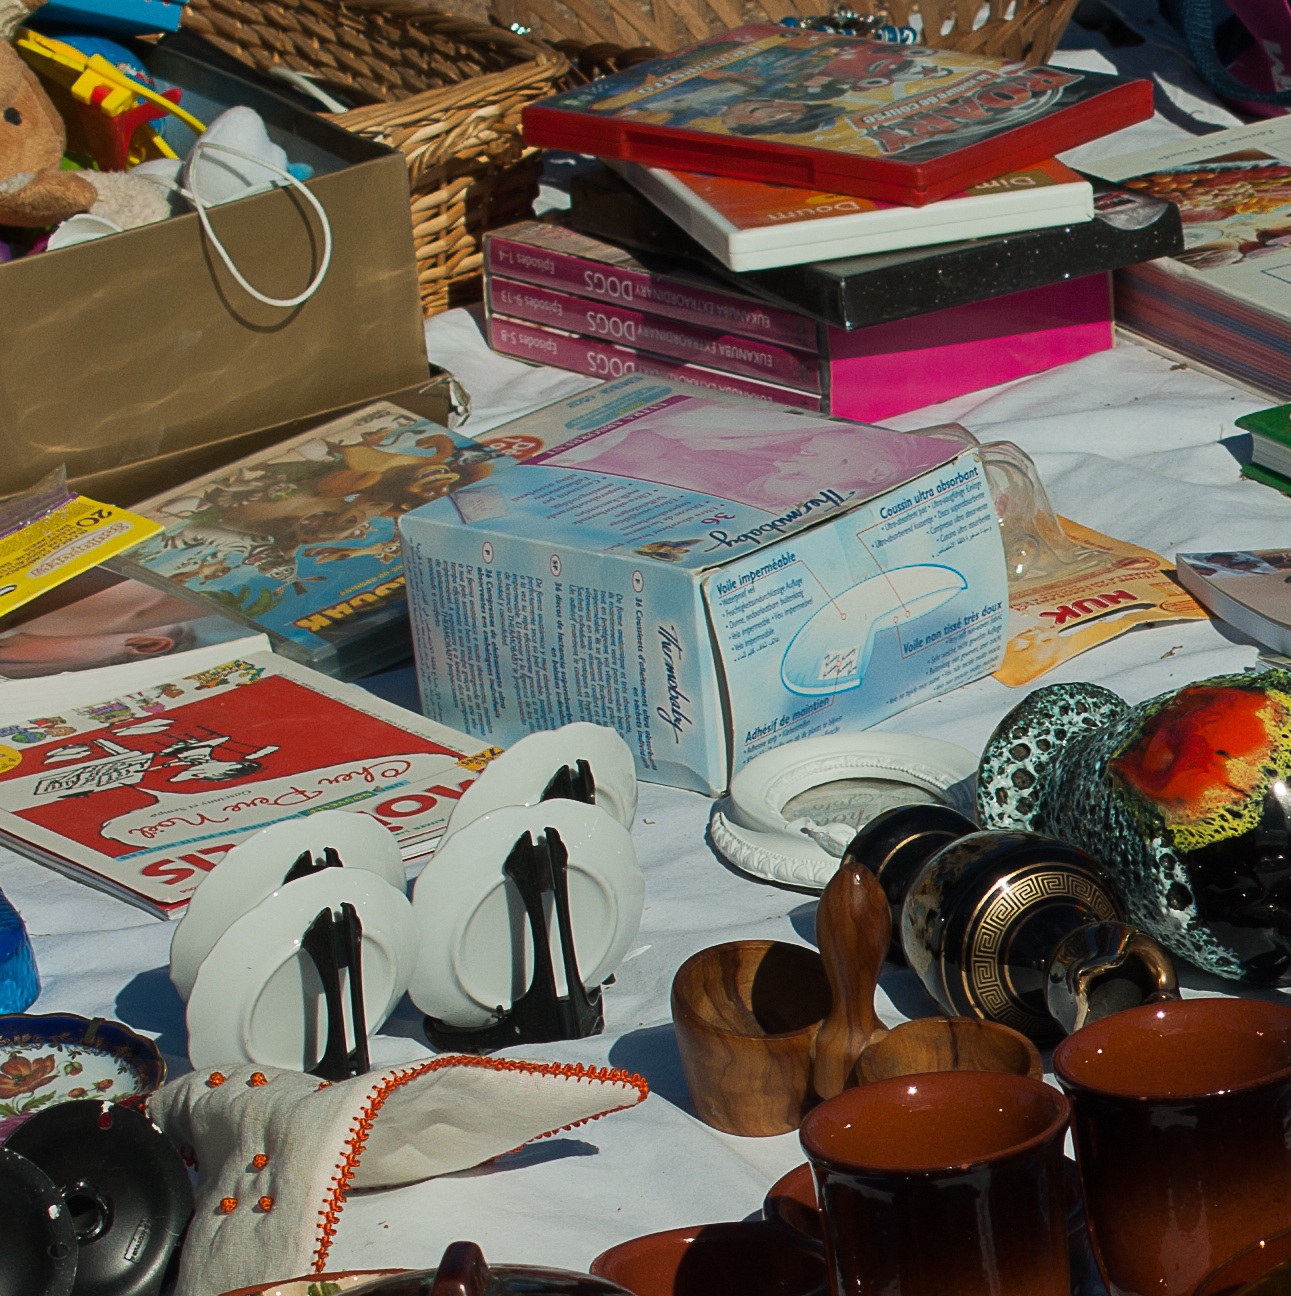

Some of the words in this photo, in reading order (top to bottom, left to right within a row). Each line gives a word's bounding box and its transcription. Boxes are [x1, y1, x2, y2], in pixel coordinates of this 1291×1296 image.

[860, 100, 921, 125] course
[870, 67, 1075, 153] ROARY
[498, 248, 514, 263] 1-4
[516, 254, 555, 274] Episodes
[500, 289, 523, 306] 9-13
[583, 270, 633, 300] DOGS
[633, 284, 713, 314] EXTRAORDINARY
[523, 294, 562, 316] Episodes
[715, 301, 770, 328] EUKANUBA
[499, 329, 517, 344] 5-8
[586, 310, 635, 341] DOGS
[636, 324, 715, 353] EXTRAORDINARY
[517, 334, 557, 354] Episodes
[718, 342, 772, 366] EUKANUBA
[586, 350, 634, 376] DOGS
[879, 495, 912, 520] Coussin
[913, 485, 934, 503] ultra
[936, 464, 978, 493] absorbant
[75, 508, 112, 527] 20
[696, 512, 739, 525] 36
[704, 488, 856, 552] Thermobaby
[716, 577, 736, 596] Voile
[738, 550, 796, 589] imperméable
[1041, 589, 1139, 625] NUK
[903, 636, 923, 655] Voile
[924, 628, 942, 644] non
[944, 617, 962, 635] tissé
[963, 609, 979, 625] très
[649, 620, 691, 747] Thermobaby
[744, 718, 779, 745] Adhésif
[781, 712, 793, 725] de
[795, 695, 830, 719] maintien
[317, 758, 410, 790] Cher
[125, 812, 228, 841] Noël
